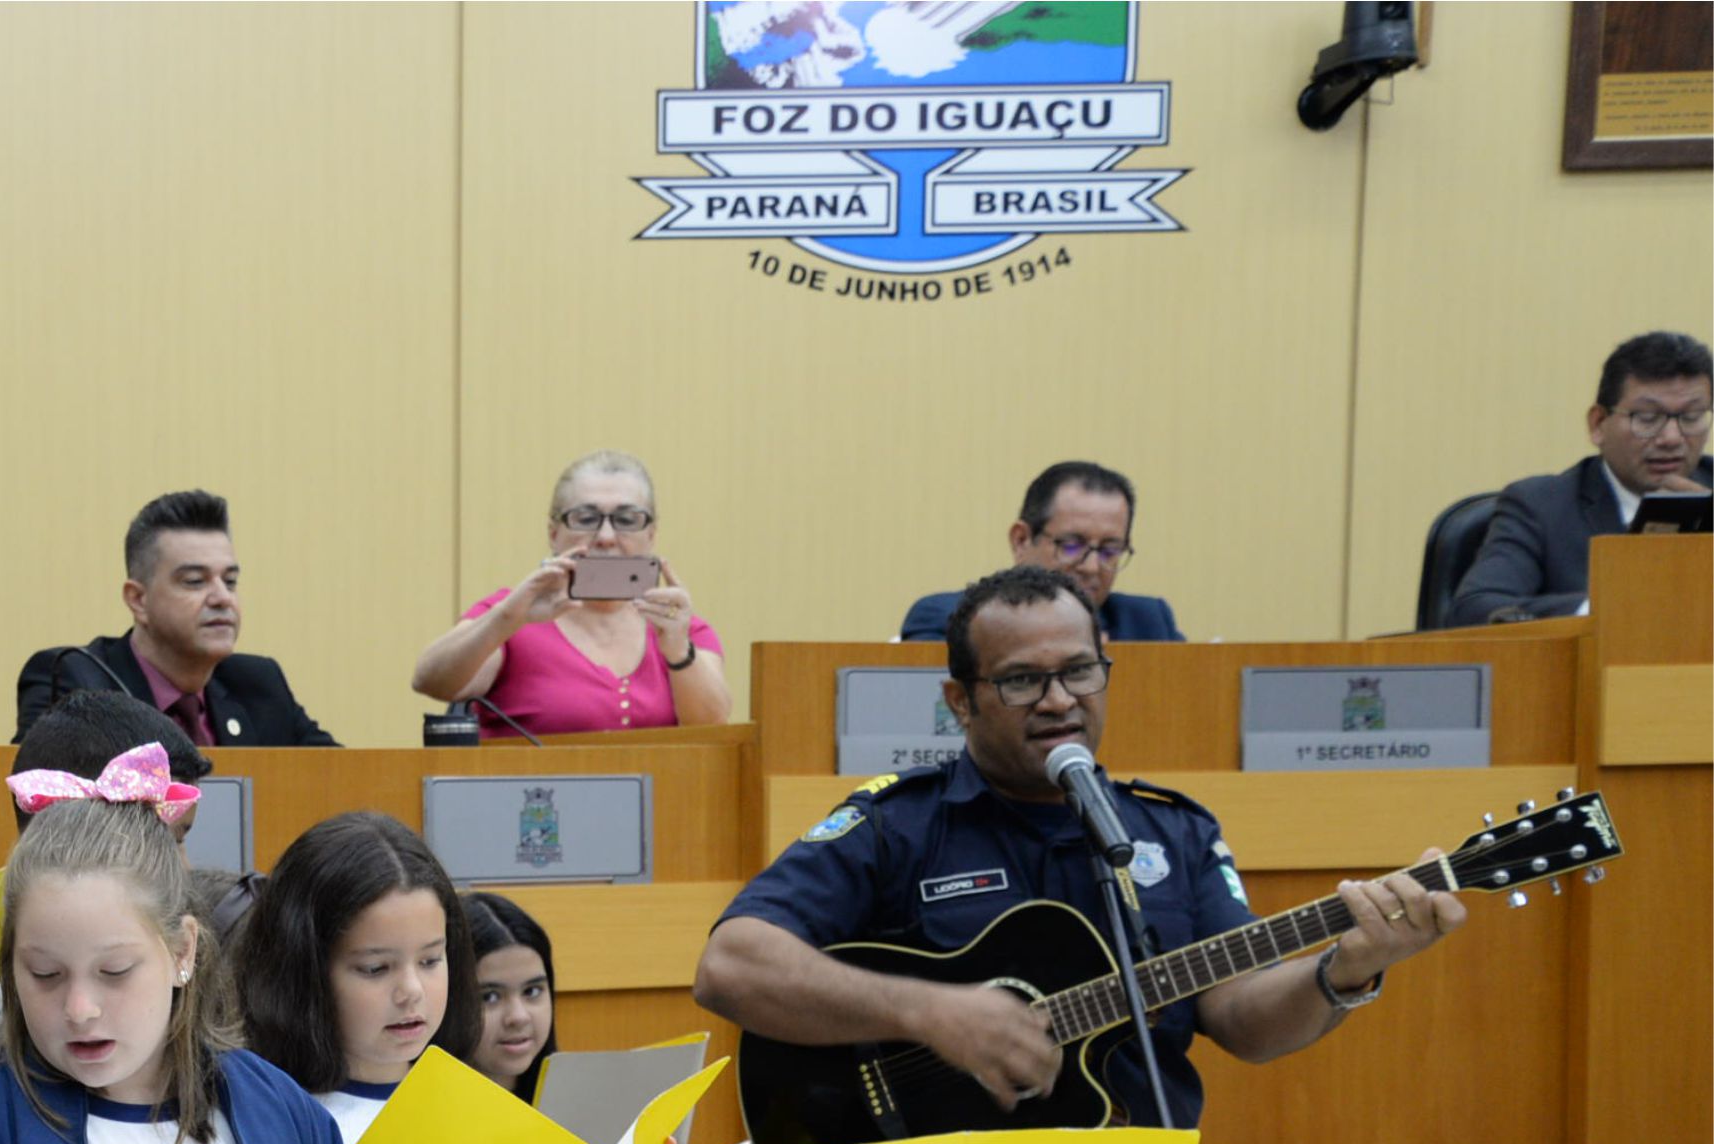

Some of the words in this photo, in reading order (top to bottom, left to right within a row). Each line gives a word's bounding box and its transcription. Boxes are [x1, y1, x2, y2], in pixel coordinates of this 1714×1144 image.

[712, 104, 810, 136] FOZ
[829, 102, 897, 133] DO
[918, 98, 1113, 139] IGUAÇU
[705, 185, 869, 220] PARANÁ
[973, 188, 1119, 216] BRASIL
[746, 249, 781, 277] 10
[787, 263, 828, 293] DE
[836, 276, 942, 303] JUNHO
[954, 272, 994, 299] DE
[1001, 246, 1074, 286] 1914
[1316, 740, 1431, 762] SECRETÁRIO
